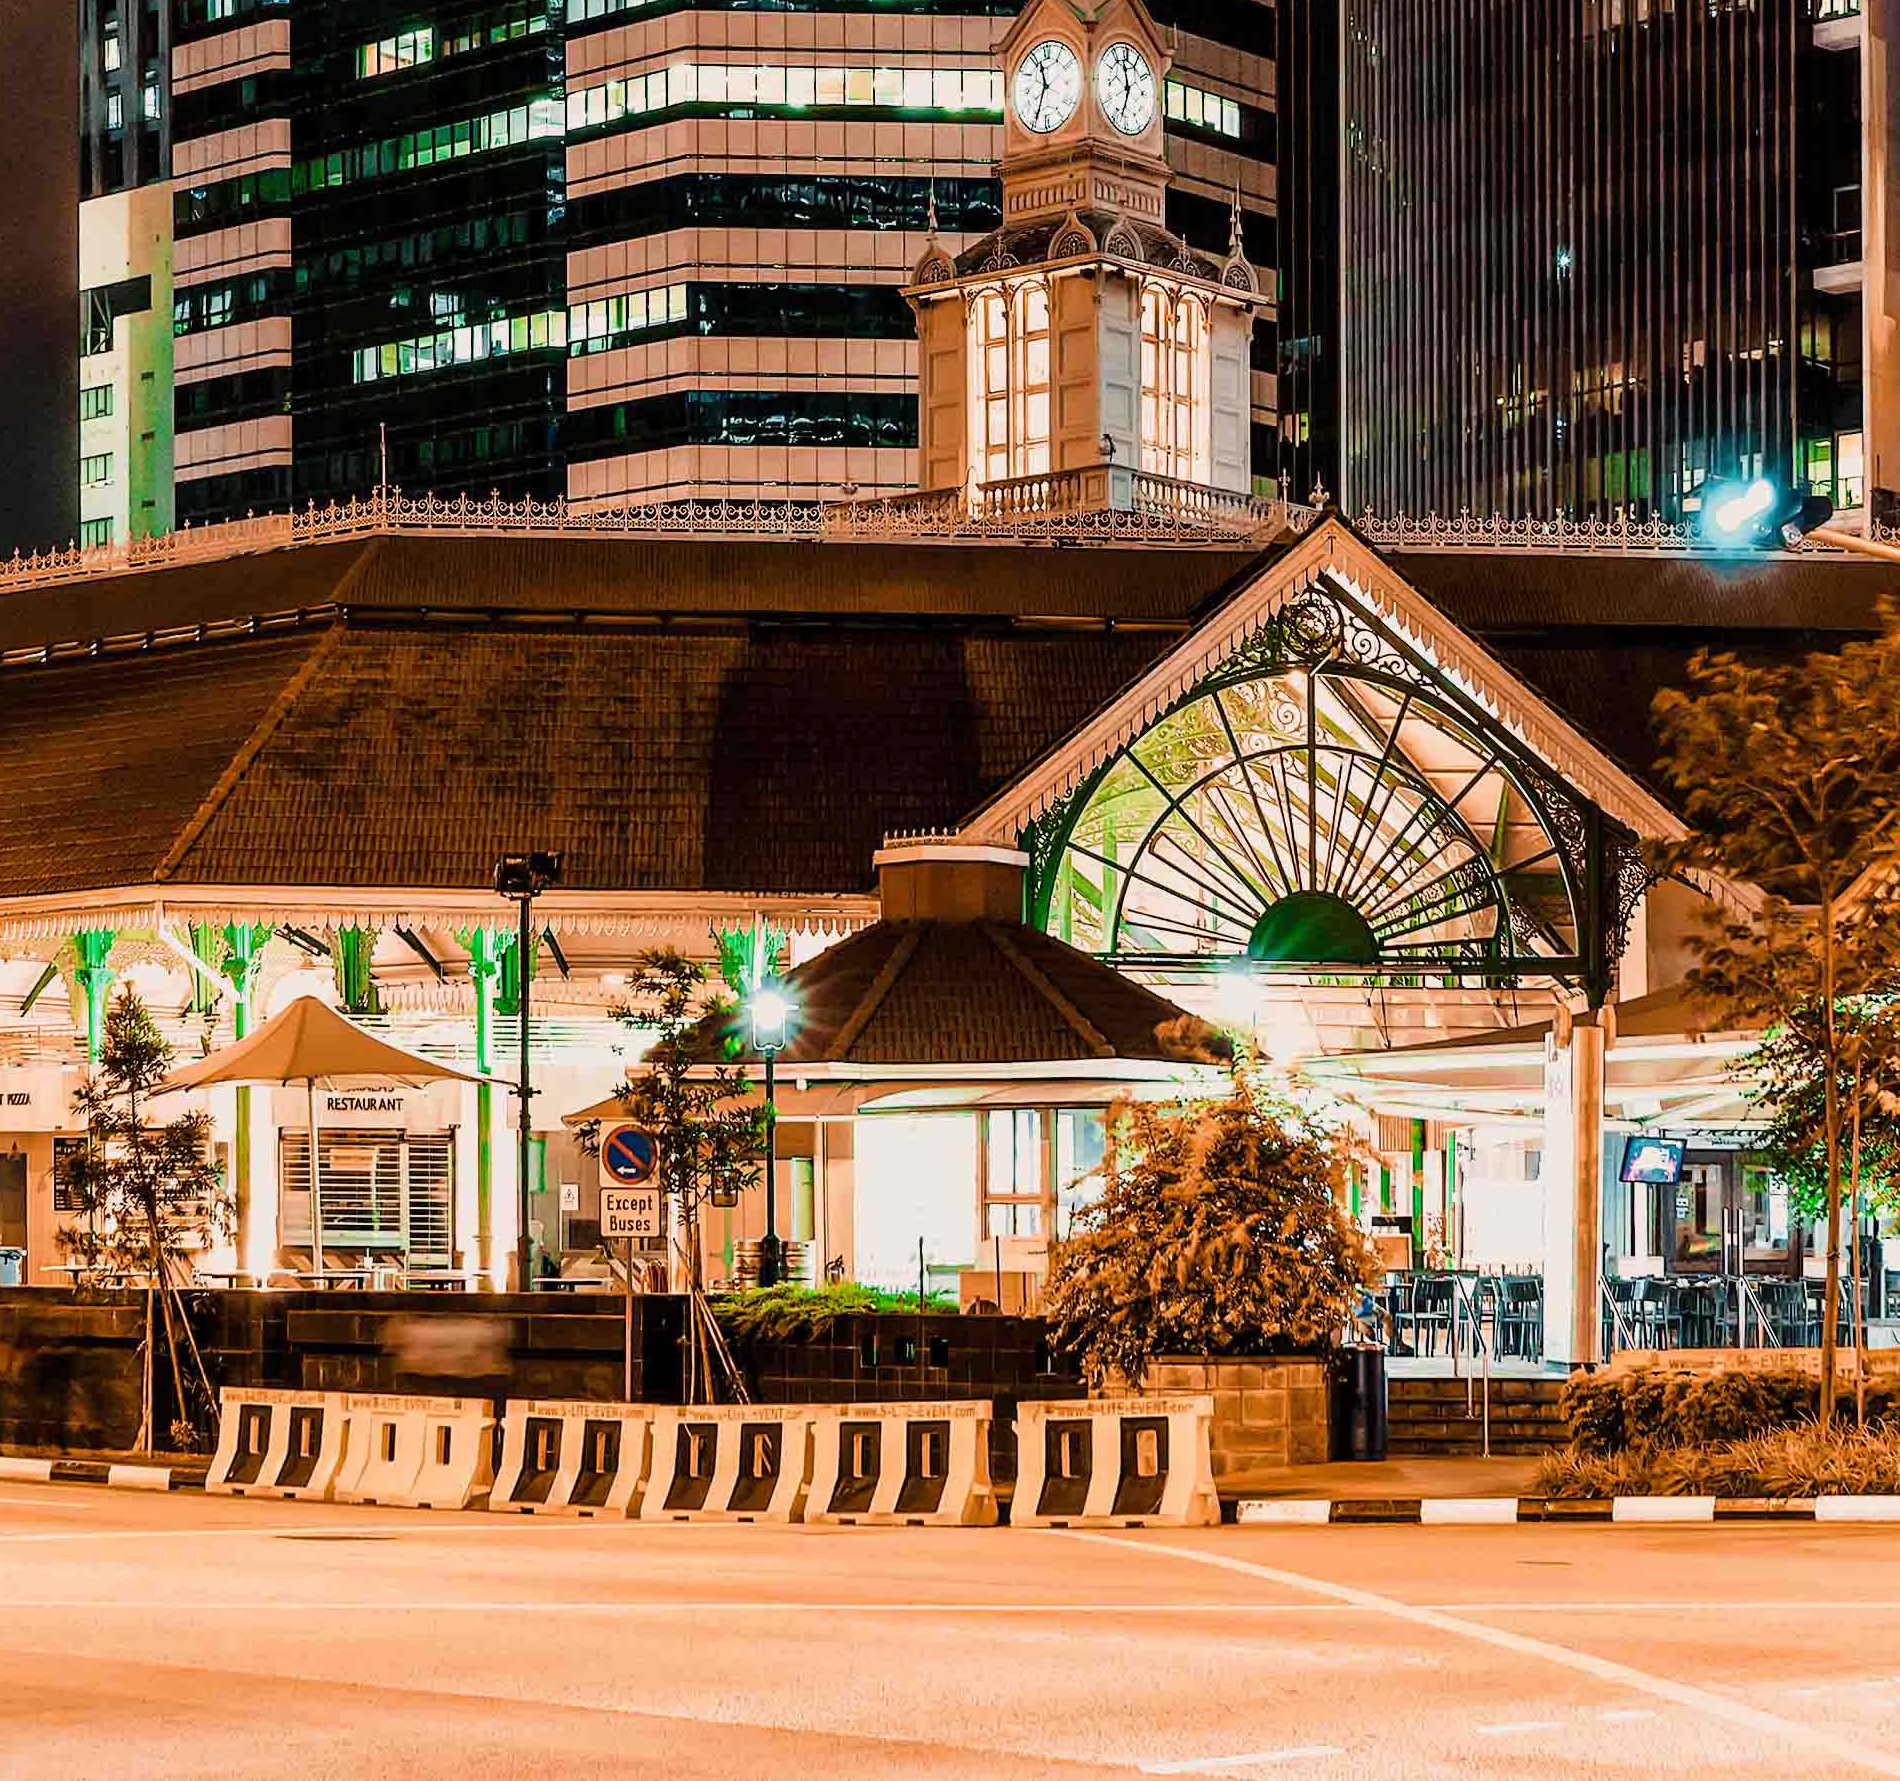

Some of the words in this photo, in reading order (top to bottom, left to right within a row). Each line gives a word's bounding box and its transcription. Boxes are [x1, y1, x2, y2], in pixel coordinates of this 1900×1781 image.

[327, 1097, 405, 1111] RESTAURANT
[606, 1194, 653, 1215] Except
[609, 1217, 651, 1232] Buses
